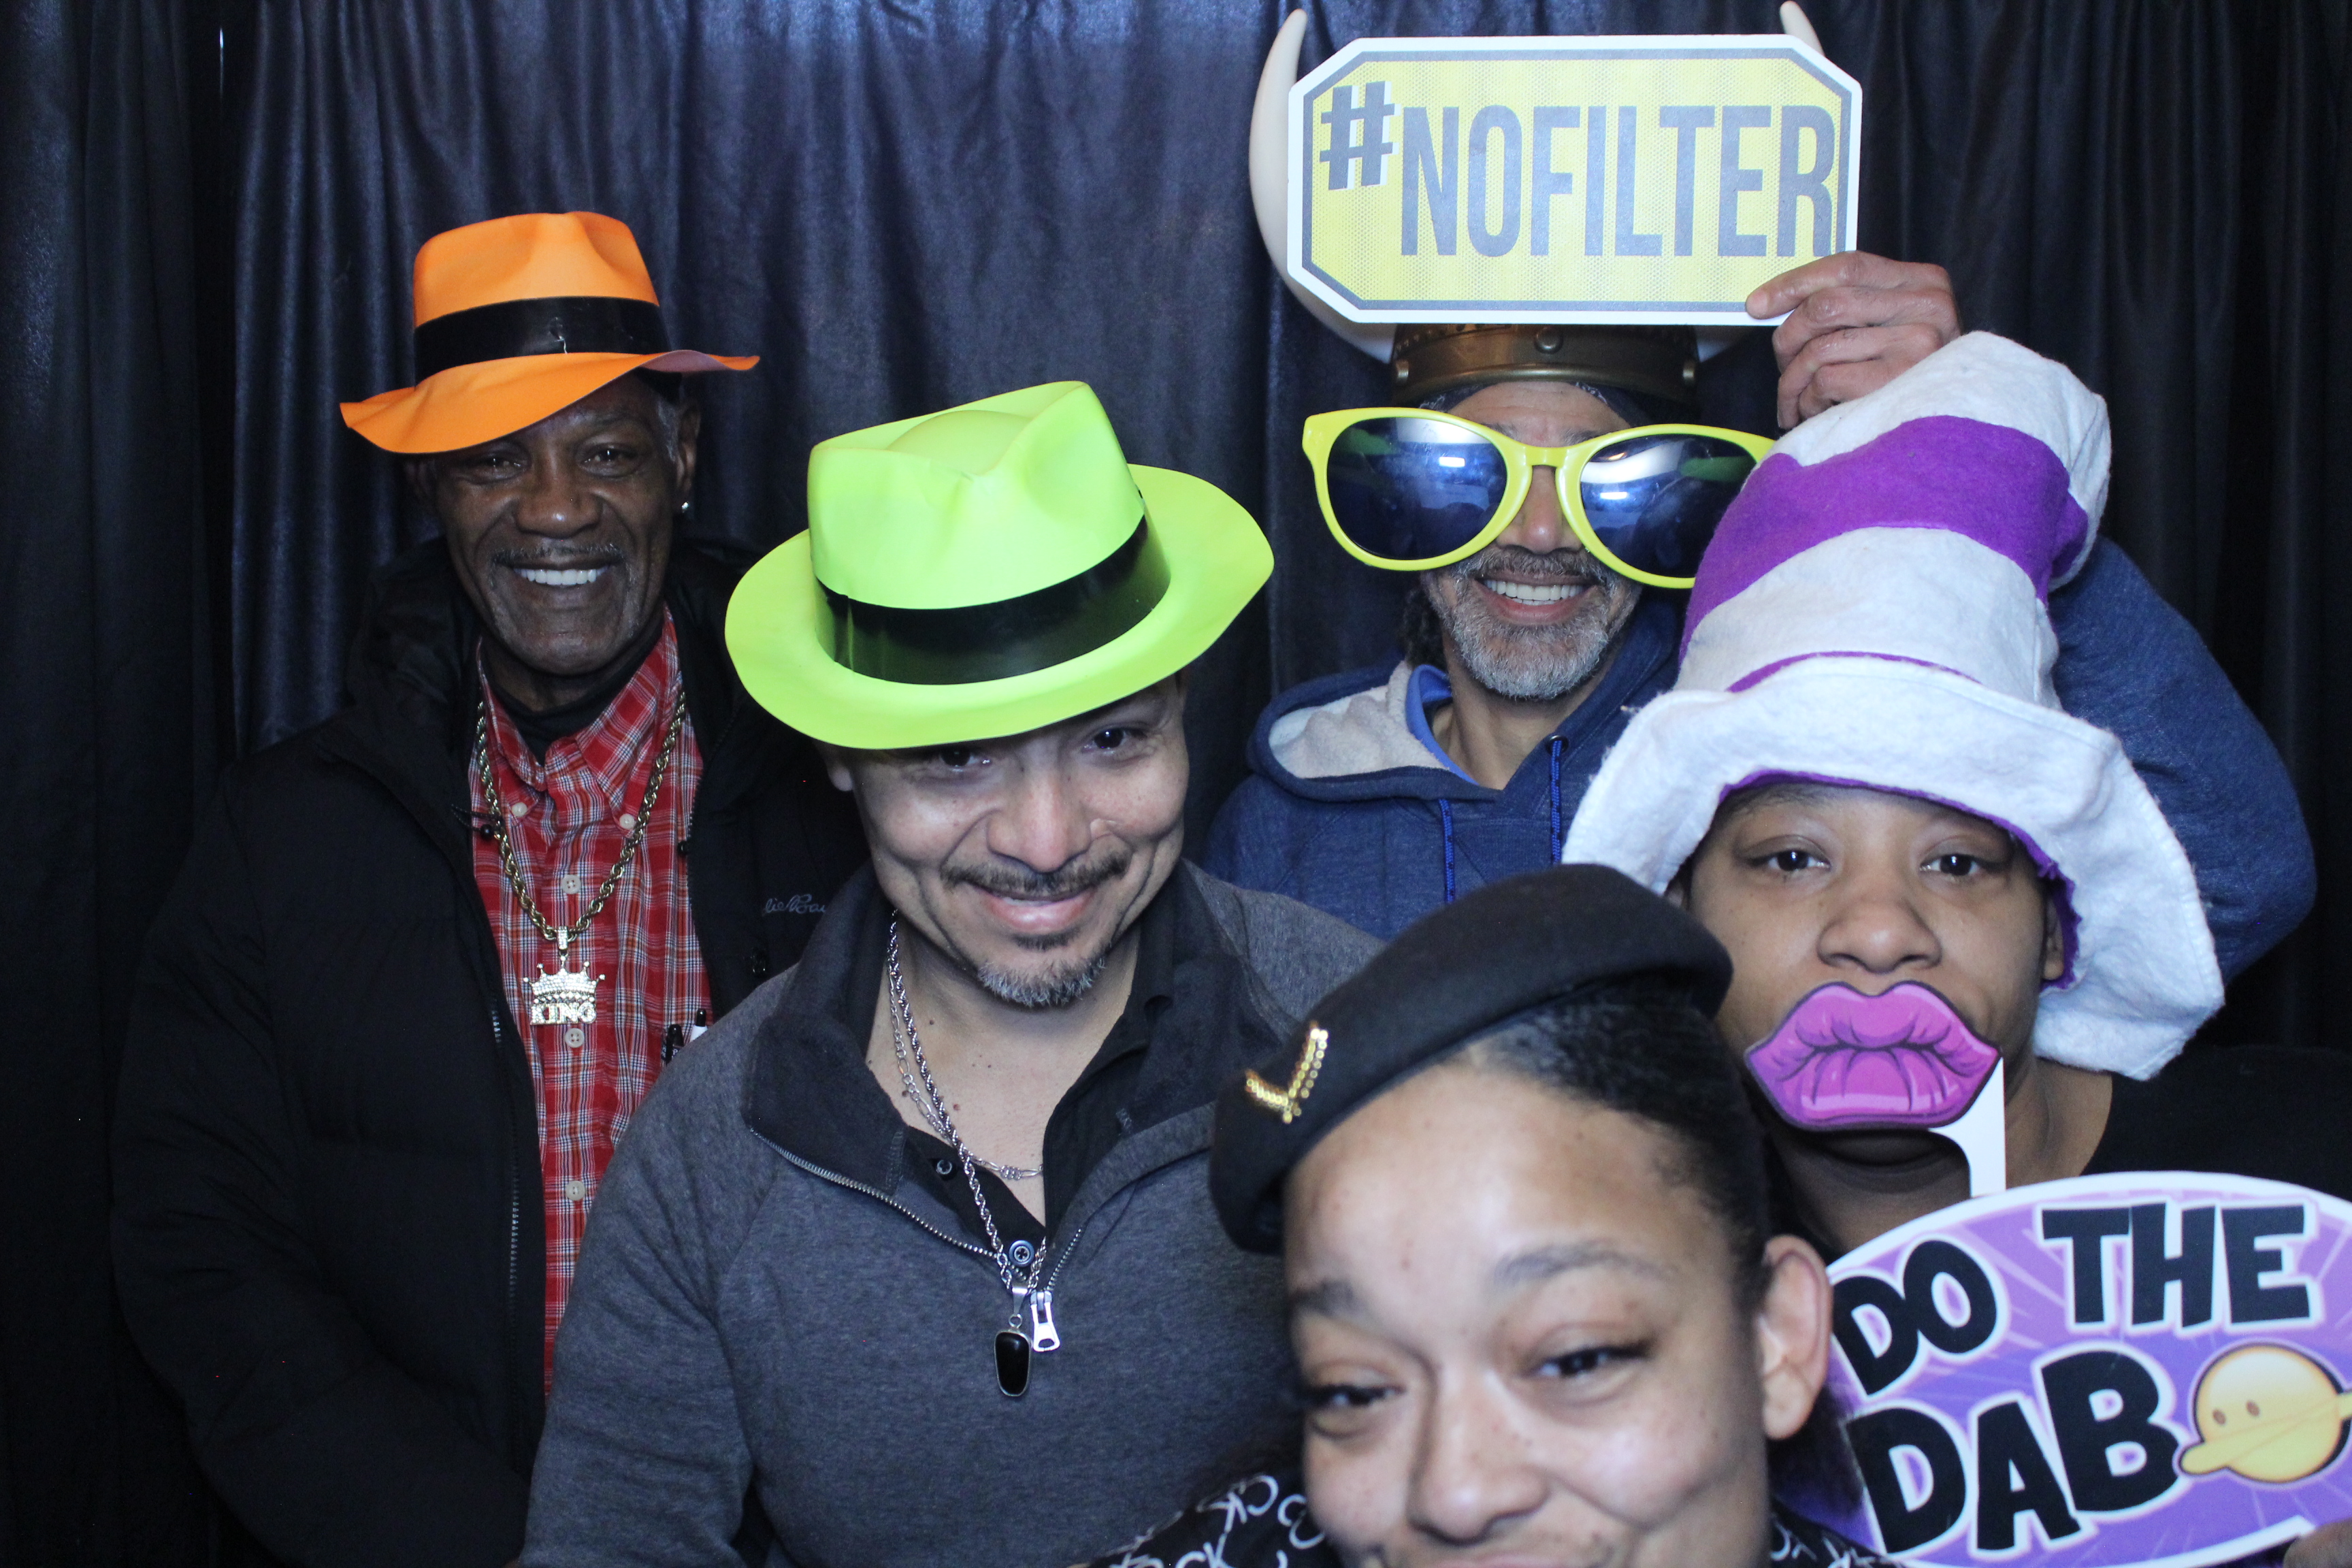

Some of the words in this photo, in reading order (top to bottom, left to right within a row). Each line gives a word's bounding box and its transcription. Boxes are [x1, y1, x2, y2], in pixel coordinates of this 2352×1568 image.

[1320, 80, 1836, 258] #NOFILTER
[529, 1002, 598, 1025] KING
[1831, 1238, 1997, 1396] DO
[2042, 1202, 2311, 1328] THE
[1845, 1350, 2180, 1555] DAB
